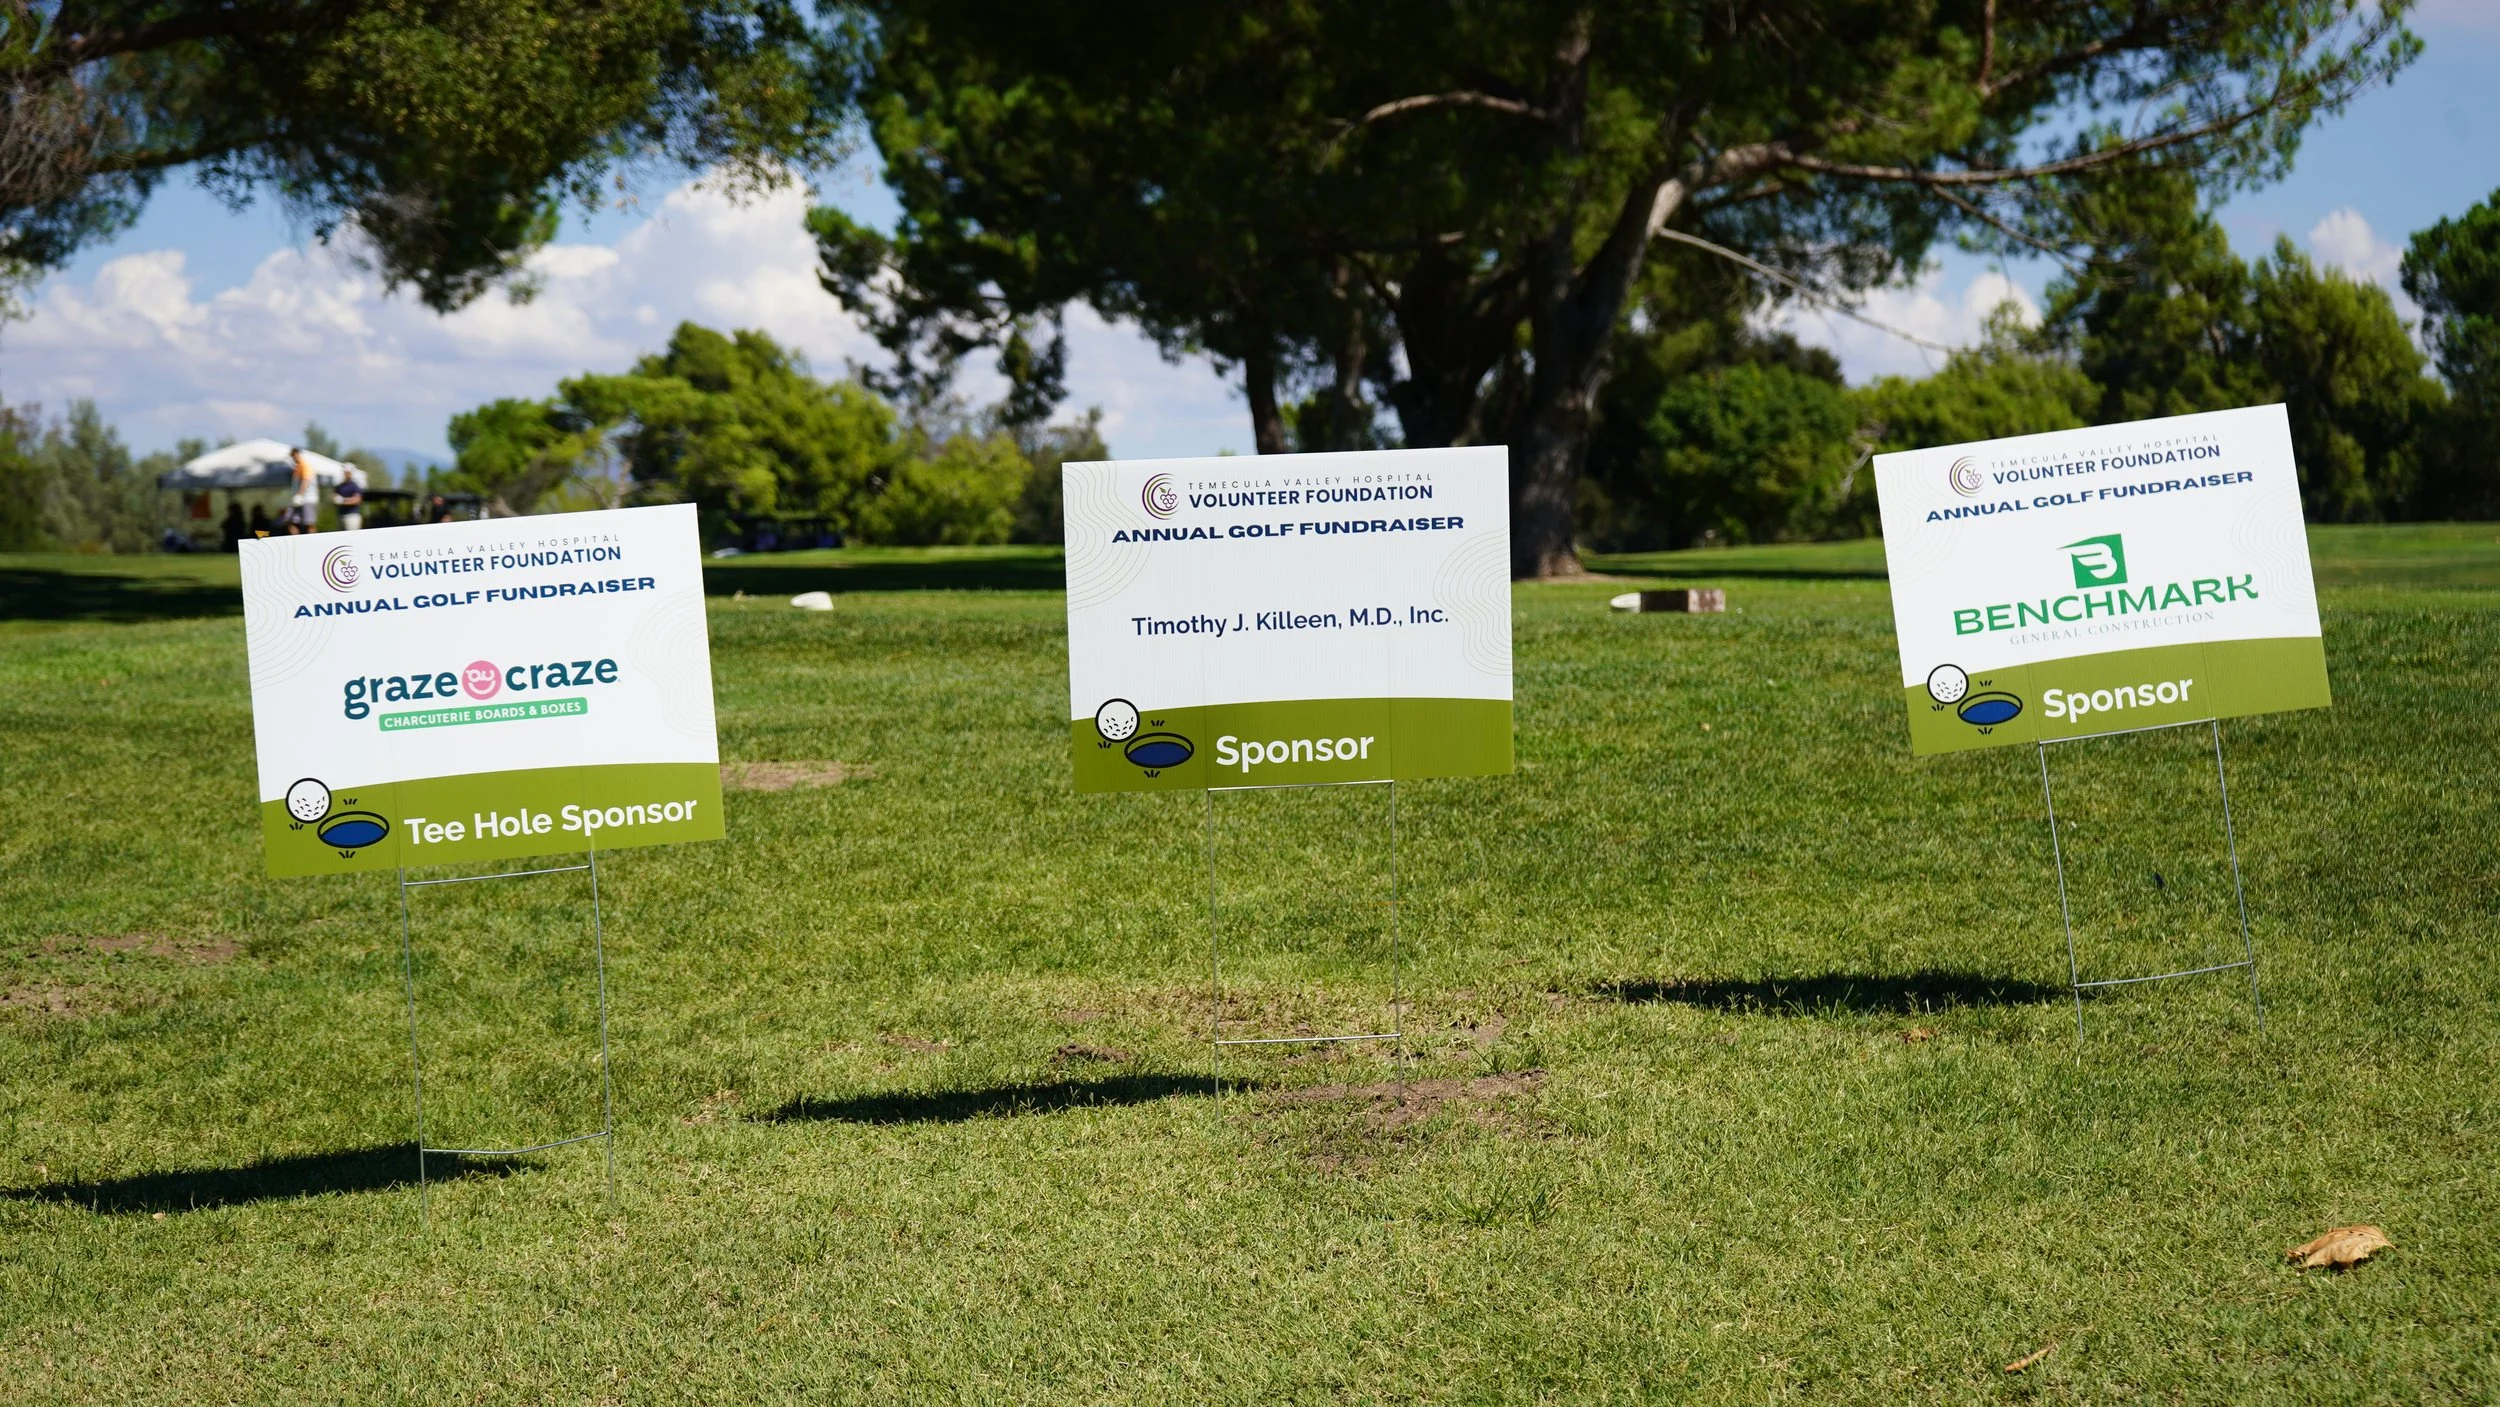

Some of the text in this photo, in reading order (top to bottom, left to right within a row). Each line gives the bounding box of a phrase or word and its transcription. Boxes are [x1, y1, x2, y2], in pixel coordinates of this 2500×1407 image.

[1991, 434, 2219, 469] TEMECULA VALLEY HOSPITAL
[1993, 445, 2221, 485] VOLUNTEER FOUNDATION
[1189, 473, 1432, 490] TEMECULA VALLEY HOSPITAL
[1189, 485, 1433, 508] VOLUNTEER FOUNDATION
[1926, 471, 2253, 523] ANNUAL GOLF FUNDRAISER
[1112, 516, 1464, 543] ANNUAL GOLF FUNDRAISER
[369, 534, 620, 561] TEMECULA VALLEY HOSPITAL
[370, 546, 622, 580] VOLUNTEER FOUNDATION
[294, 576, 656, 618] ANNUAL GOLF FUNDRAISER
[1953, 573, 2259, 636] BENCHMARK
[1132, 605, 1449, 637] Timothy J. Killeen, M.D., Inc.
[2010, 611, 2215, 645] GENERAL CONSTRUCTION
[344, 657, 618, 720] graze craze
[2043, 679, 2193, 723] Sponsor
[383, 700, 581, 729] CHARCUTERIE BOARDS & BOXES
[1216, 735, 1375, 773] Sponsor
[404, 800, 697, 845] Tee Hole Sponsor
